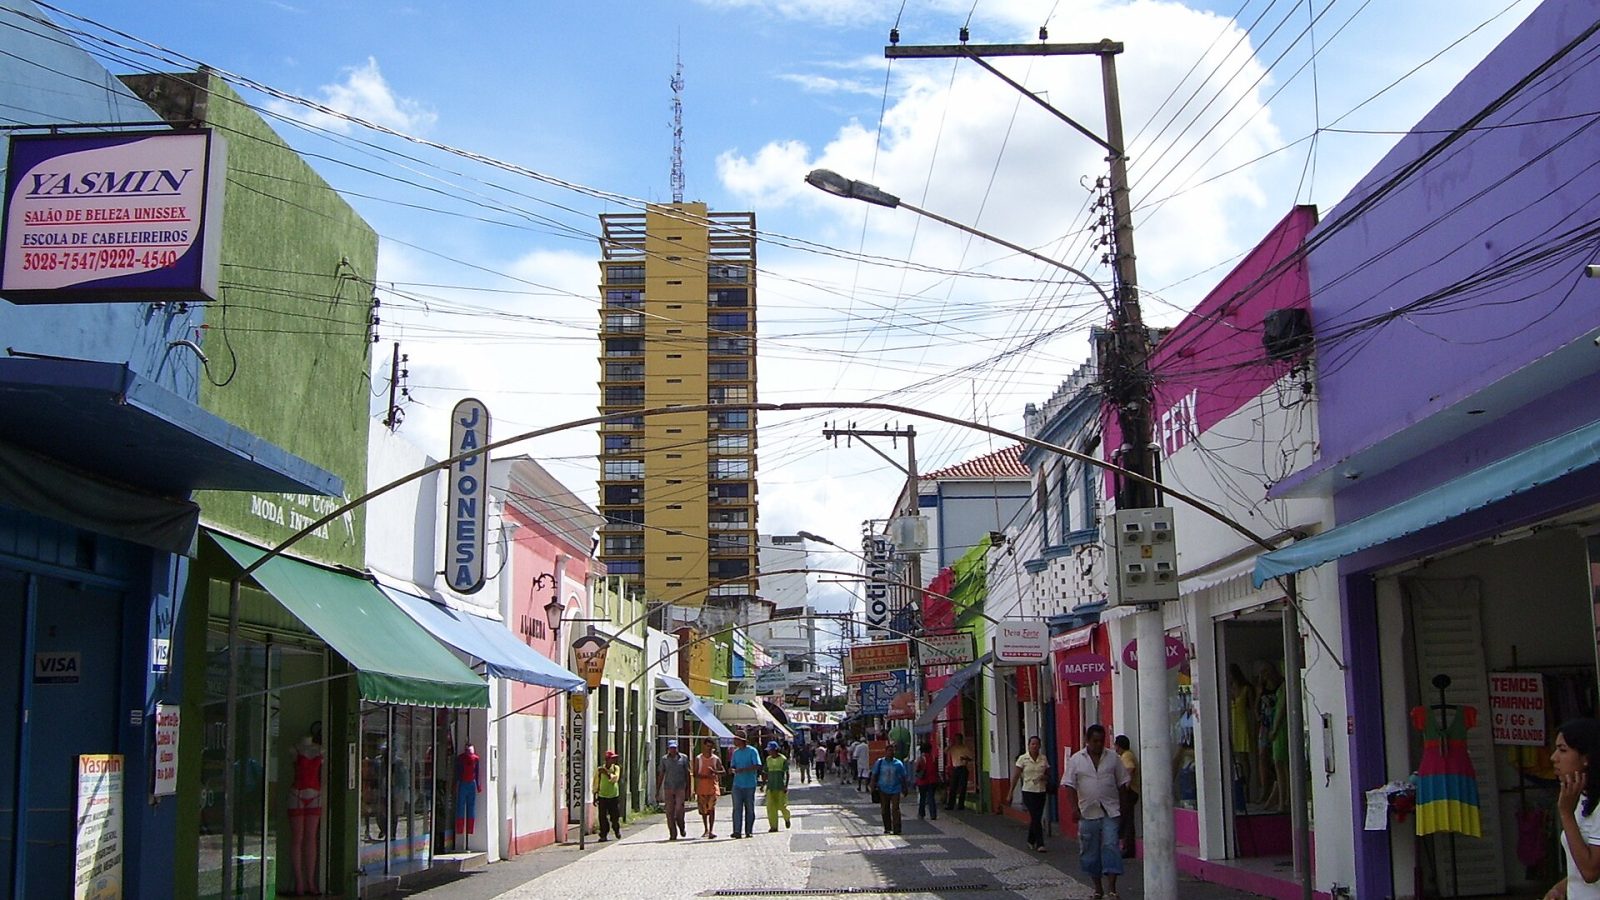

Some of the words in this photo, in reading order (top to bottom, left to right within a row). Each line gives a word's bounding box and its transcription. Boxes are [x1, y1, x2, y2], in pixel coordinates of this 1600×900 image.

[26, 168, 193, 195] YASMIN
[24, 207, 63, 223] SALÃO
[66, 208, 82, 222] DE
[85, 207, 130, 221] BELEZA
[134, 206, 186, 220] UNISSEX
[23, 233, 68, 246] ESCOLA
[71, 232, 89, 245] DE
[92, 230, 188, 245] CABELEIREIROS
[23, 248, 178, 271] 3028-7547/9222-4540
[454, 408, 479, 586] JAPONESA
[251, 494, 285, 526] MODA
[40, 657, 77, 672] VISA
[1065, 662, 1105, 674] MAFFIX
[1492, 677, 1538, 692] TEMOS
[1495, 713, 1503, 725] G
[1511, 714, 1525, 726] GG
[1512, 728, 1543, 741] GRANDE
[81, 756, 120, 774] Yasmin
